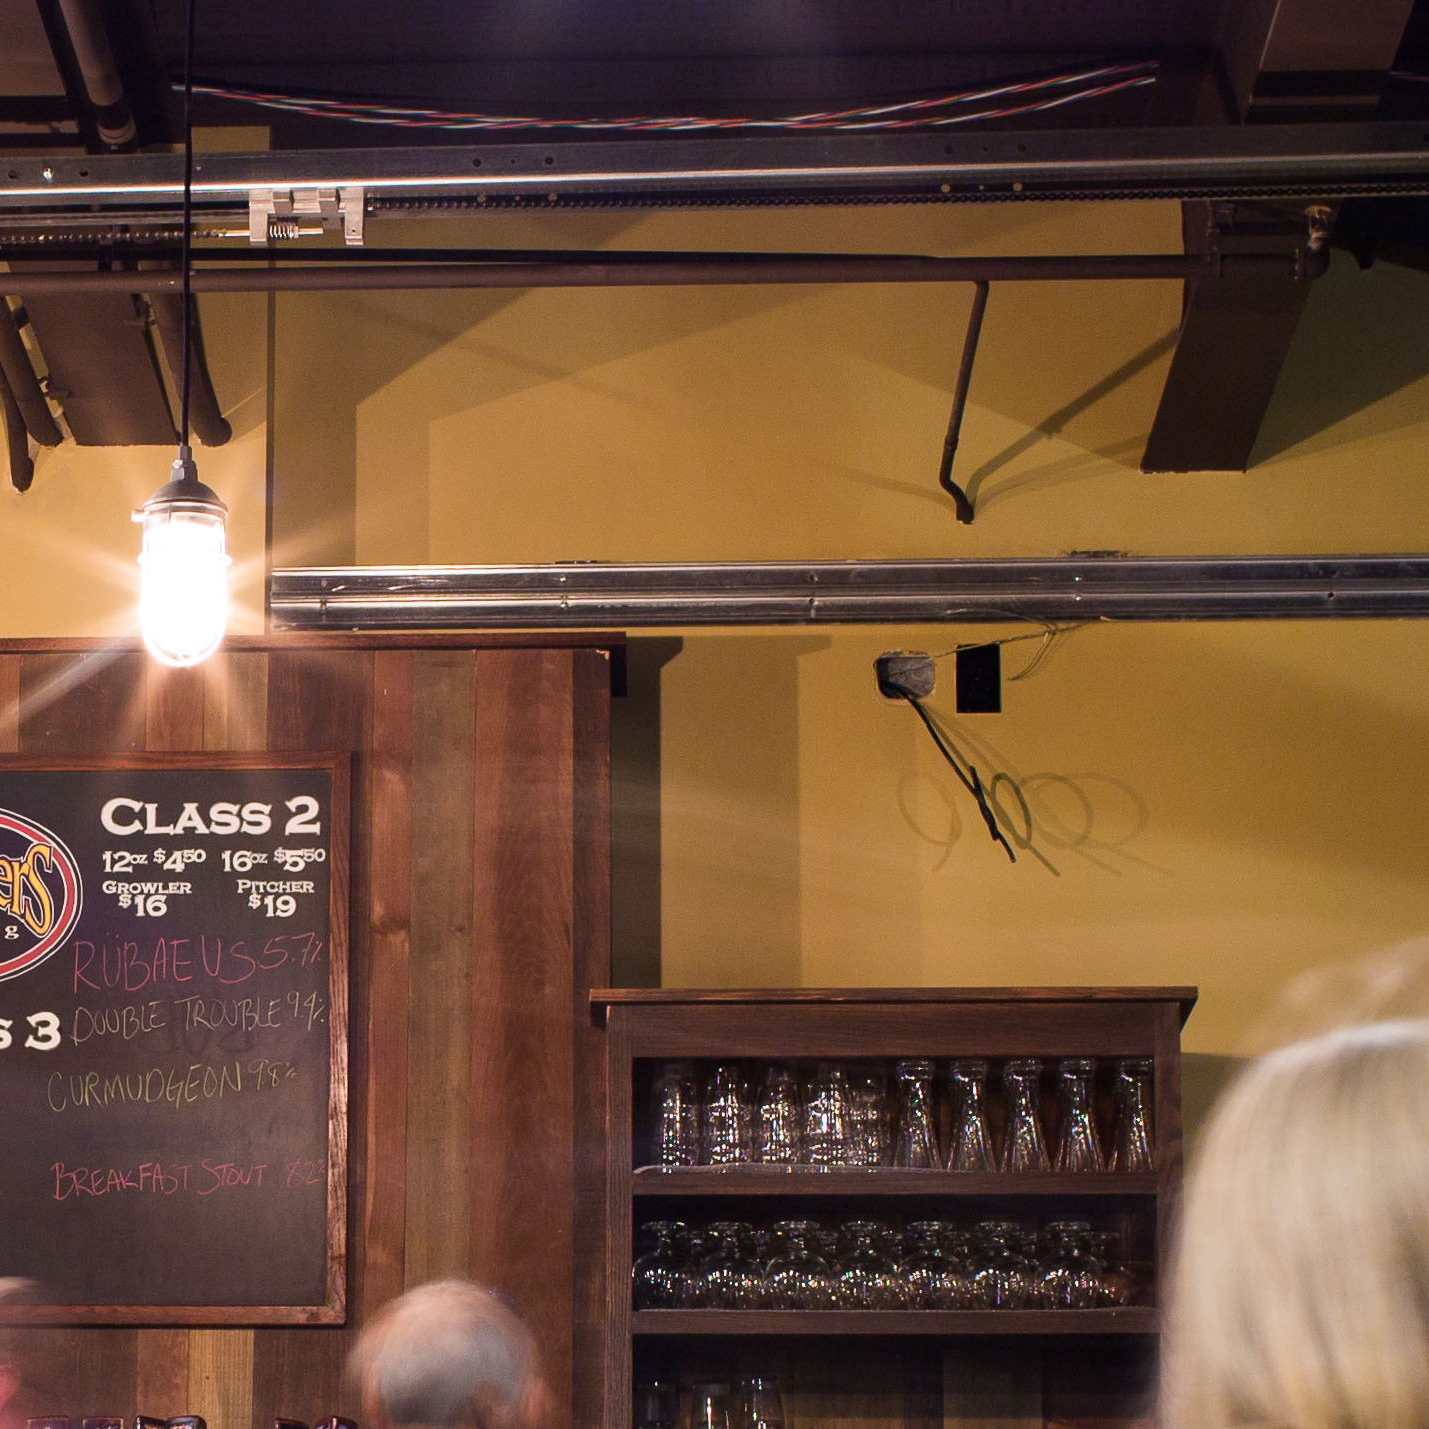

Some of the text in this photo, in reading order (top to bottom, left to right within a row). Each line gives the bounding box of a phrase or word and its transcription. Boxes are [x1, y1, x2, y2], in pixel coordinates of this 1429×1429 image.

[101, 795, 321, 836] CLASS 2
[102, 880, 192, 894] GROWLER
[237, 879, 315, 893] PITCHER
[118, 893, 167, 917] $16
[248, 891, 297, 917] $19
[24, 1011, 61, 1051] 3
[70, 1000, 166, 1047] DOUBLE
[174, 994, 282, 1032] TROUBLE
[51, 1162, 191, 1200] BREAKFAST
[198, 1158, 268, 1195] STOUT
